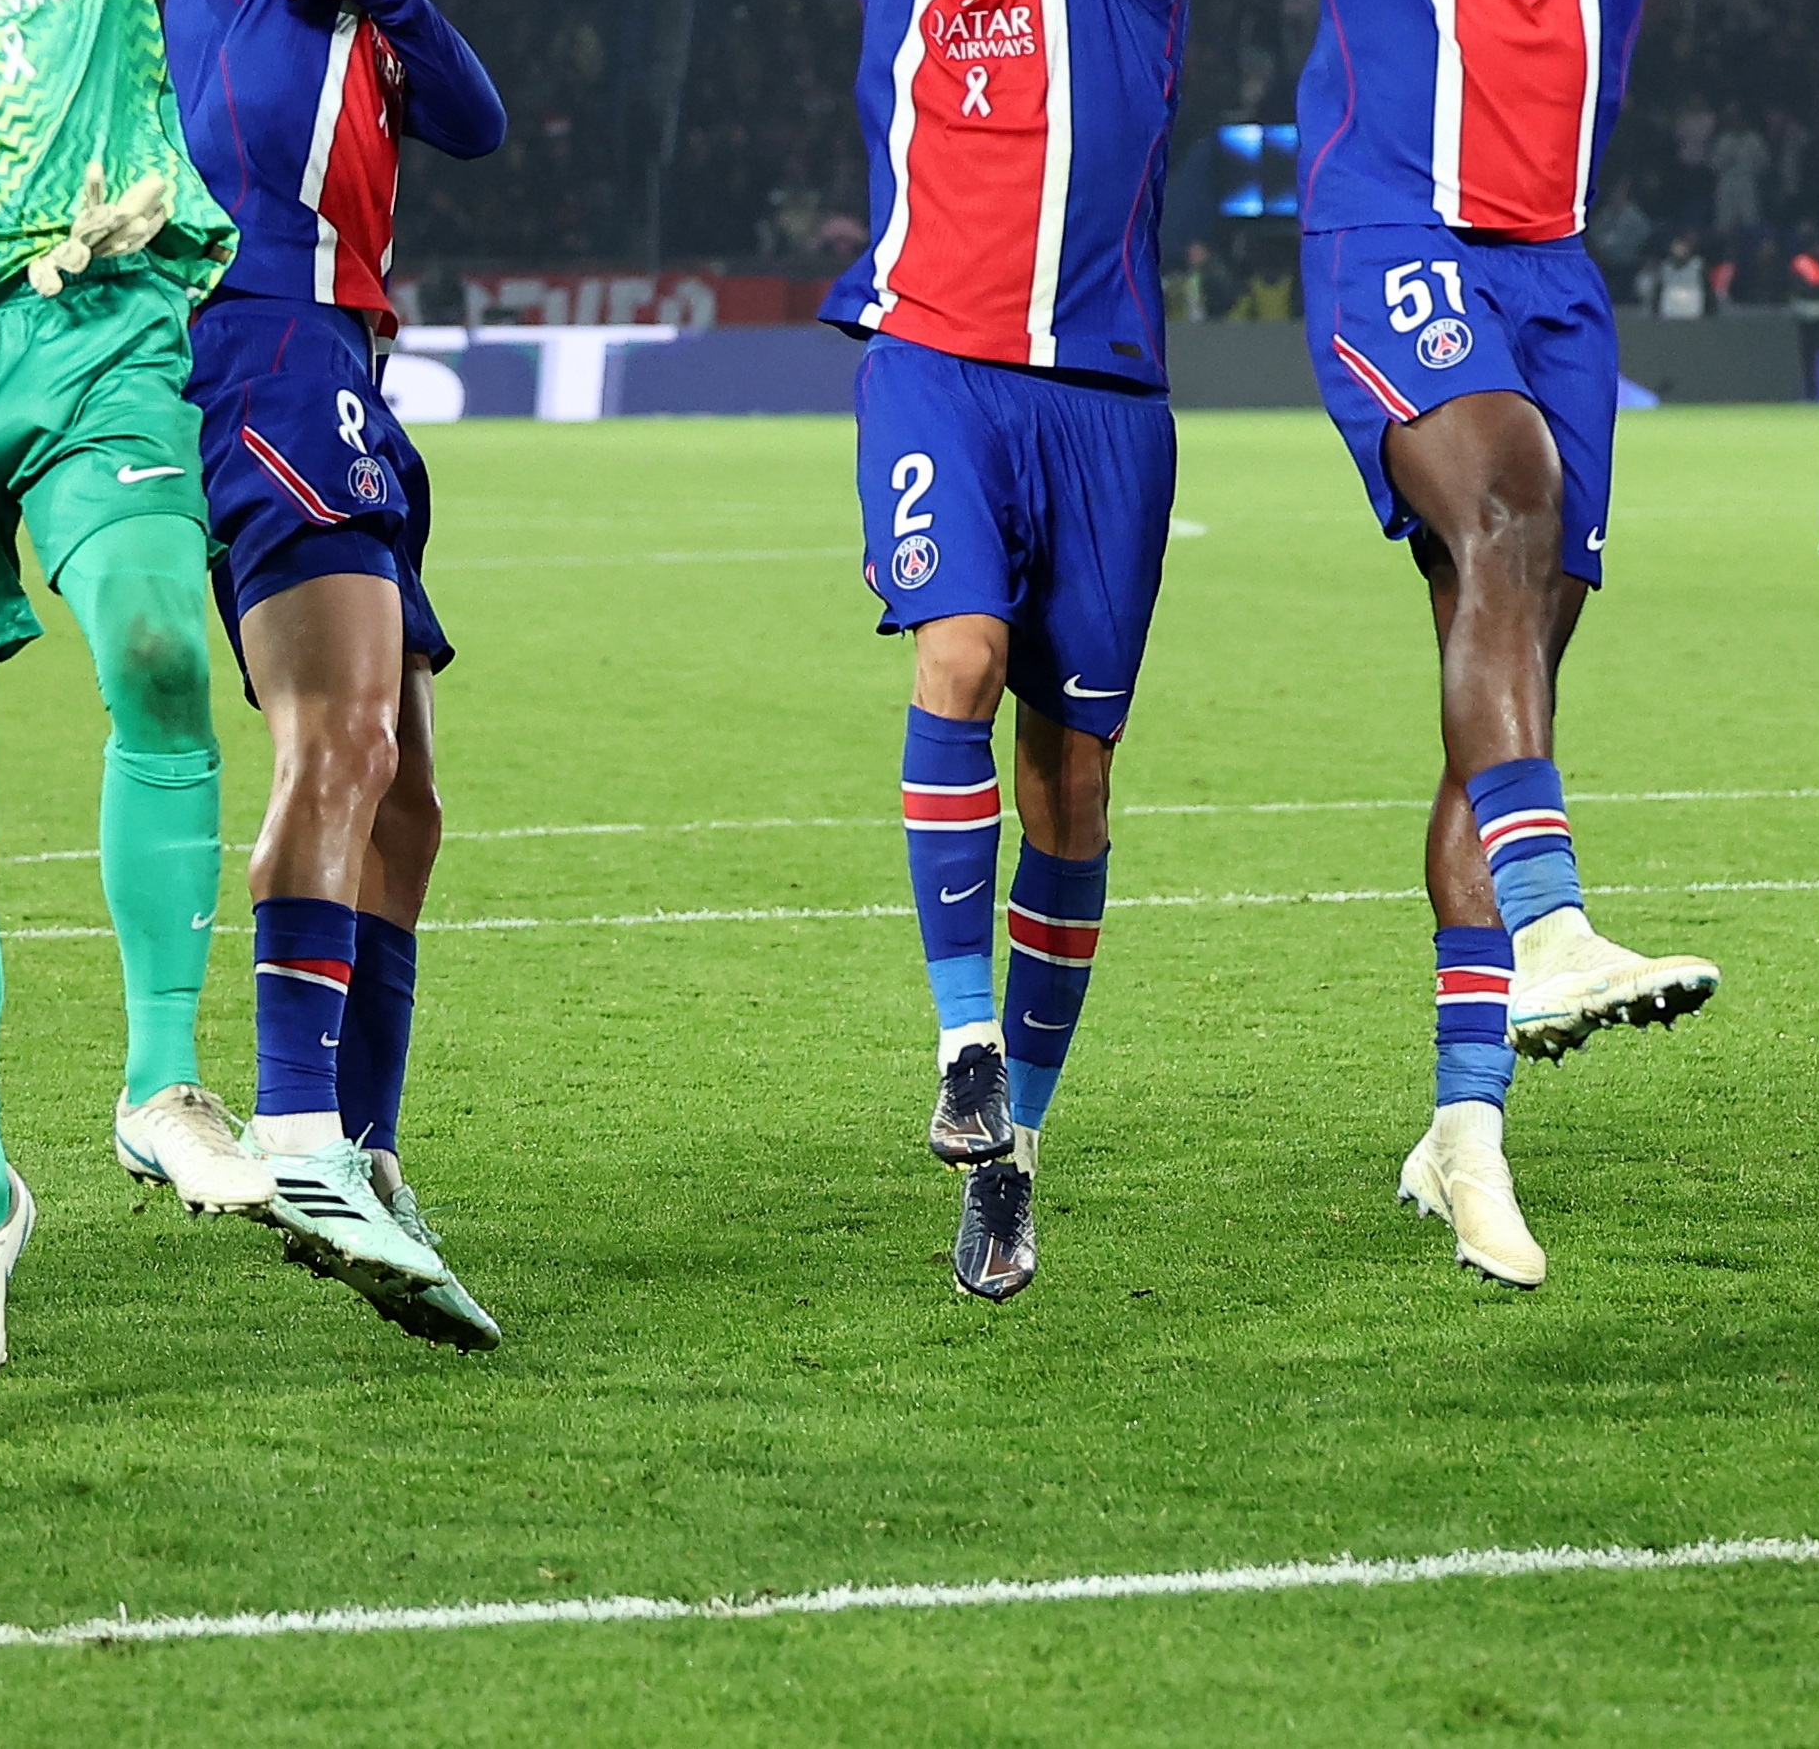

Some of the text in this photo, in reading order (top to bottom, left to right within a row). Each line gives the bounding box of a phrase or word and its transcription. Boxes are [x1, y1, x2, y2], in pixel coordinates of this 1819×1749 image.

[929, 6, 1034, 46] QATAR
[945, 35, 1037, 61] AIRWAYS
[1384, 258, 1467, 334] 51
[890, 451, 936, 539] 2
